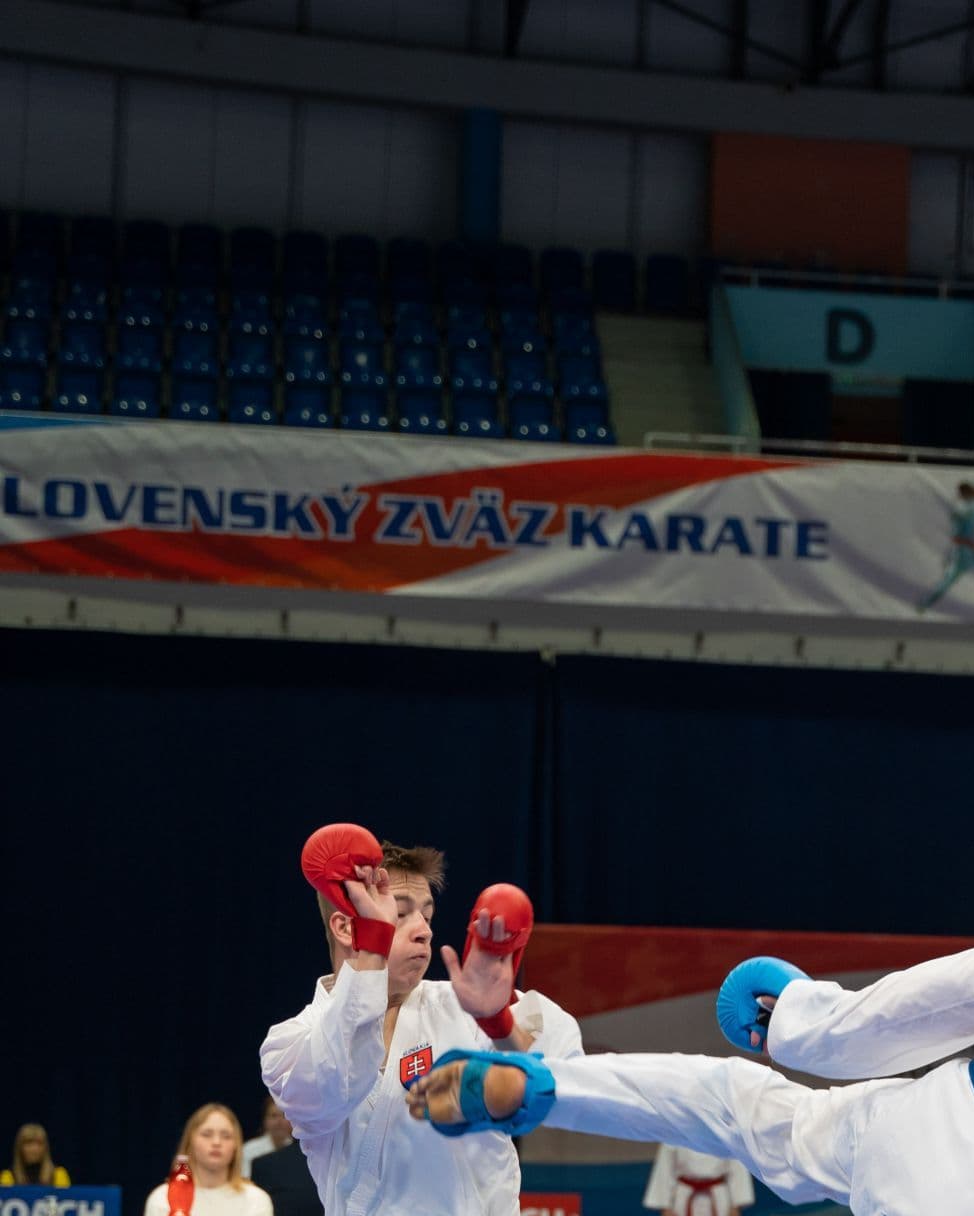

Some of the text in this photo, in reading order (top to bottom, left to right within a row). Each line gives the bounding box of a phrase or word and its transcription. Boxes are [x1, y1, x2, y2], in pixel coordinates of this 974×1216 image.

[825, 308, 876, 363] D
[377, 493, 548, 547] ZVÄZ
[570, 511, 830, 560] KARATE
